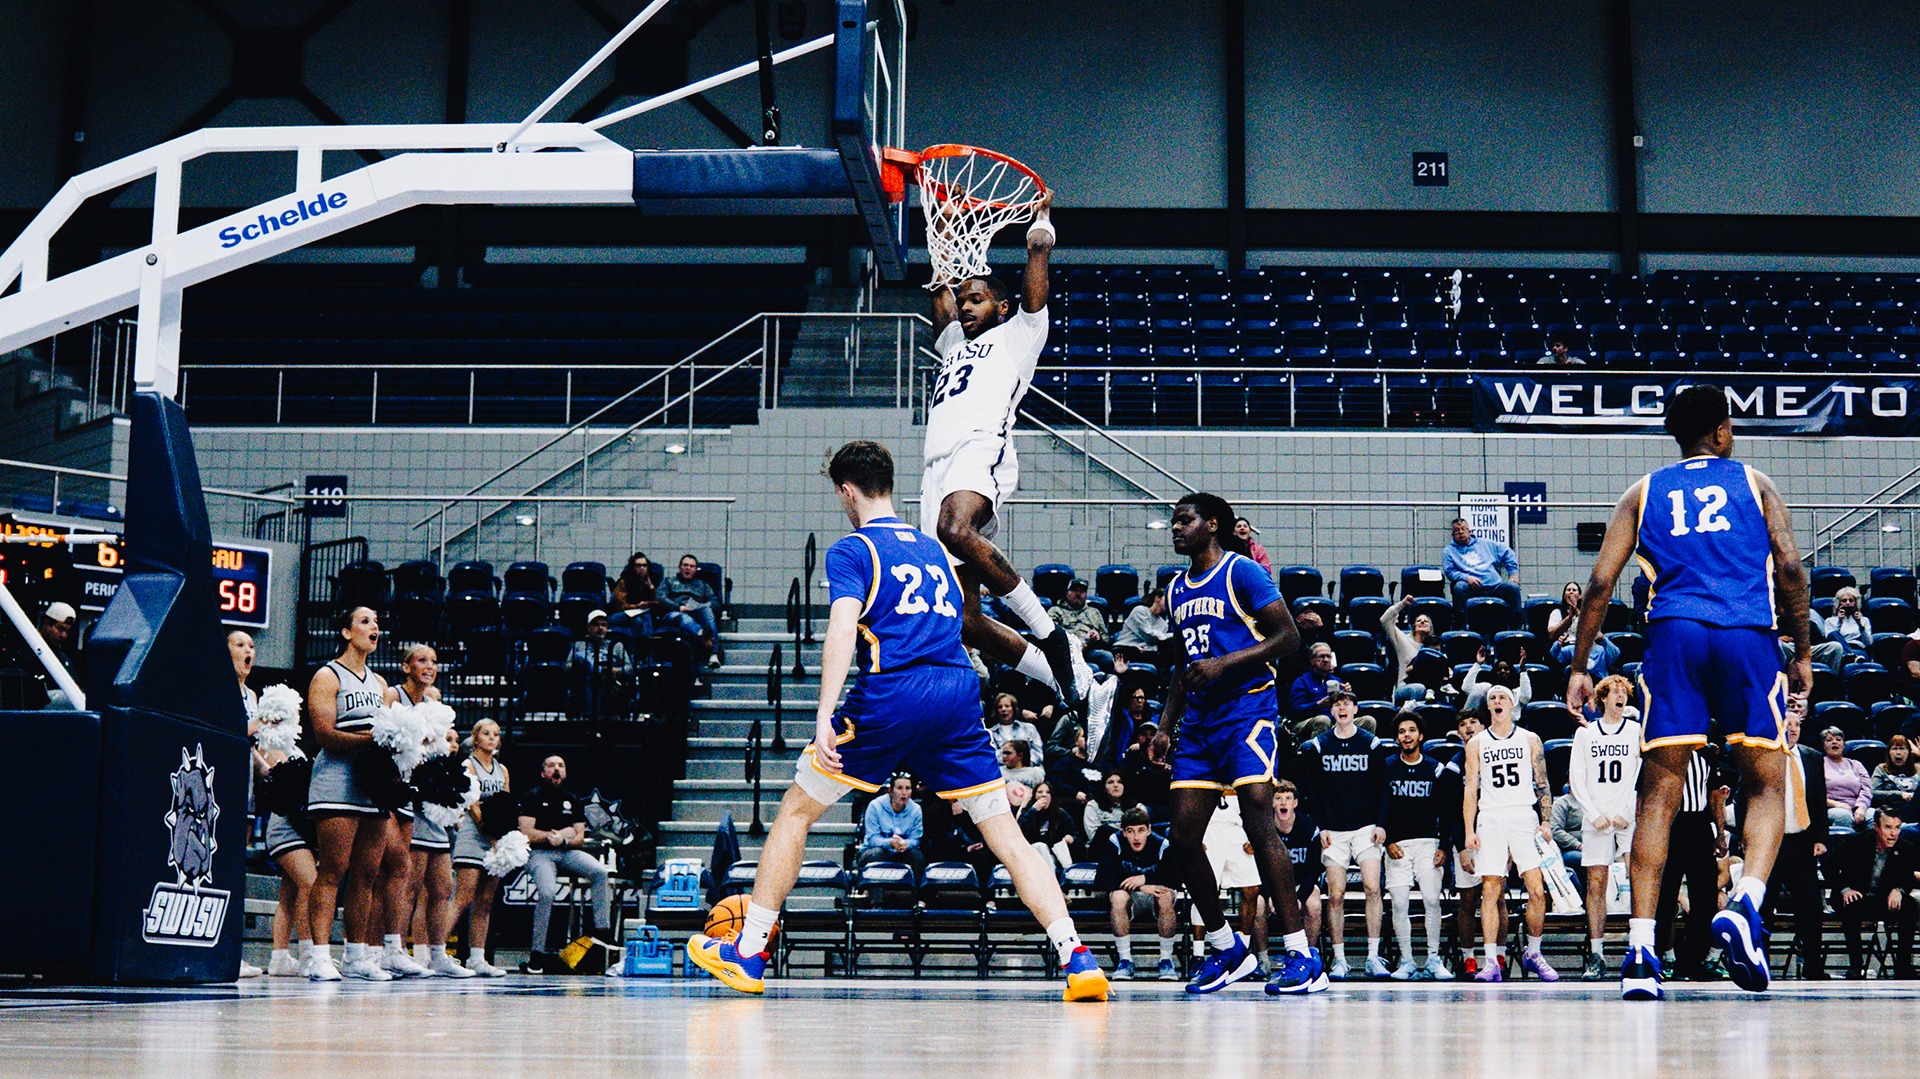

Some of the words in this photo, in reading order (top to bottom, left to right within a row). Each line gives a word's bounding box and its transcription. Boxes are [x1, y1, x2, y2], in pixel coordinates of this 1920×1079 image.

[1417, 161, 1446, 177] 211
[218, 192, 348, 249] Schelde
[931, 363, 974, 409] 23
[1494, 382, 1808, 416] WELCME
[1831, 386, 1908, 418] TO
[309, 486, 344, 506] 110
[1470, 498, 1498, 512] HOME
[1510, 493, 1542, 512] 111
[1471, 513, 1498, 527] TEAM
[1667, 485, 1732, 537] 12
[1471, 528, 1506, 543] EATING
[219, 579, 256, 613] 58
[890, 563, 958, 619] 22
[1182, 623, 1211, 656] 25
[1483, 747, 1524, 764] SWOSU
[1590, 744, 1629, 758] SWOSU
[1322, 754, 1369, 772] SWOSU
[1597, 760, 1622, 783] 10
[1491, 762, 1520, 788] 55
[146, 890, 226, 938] SWOSU
